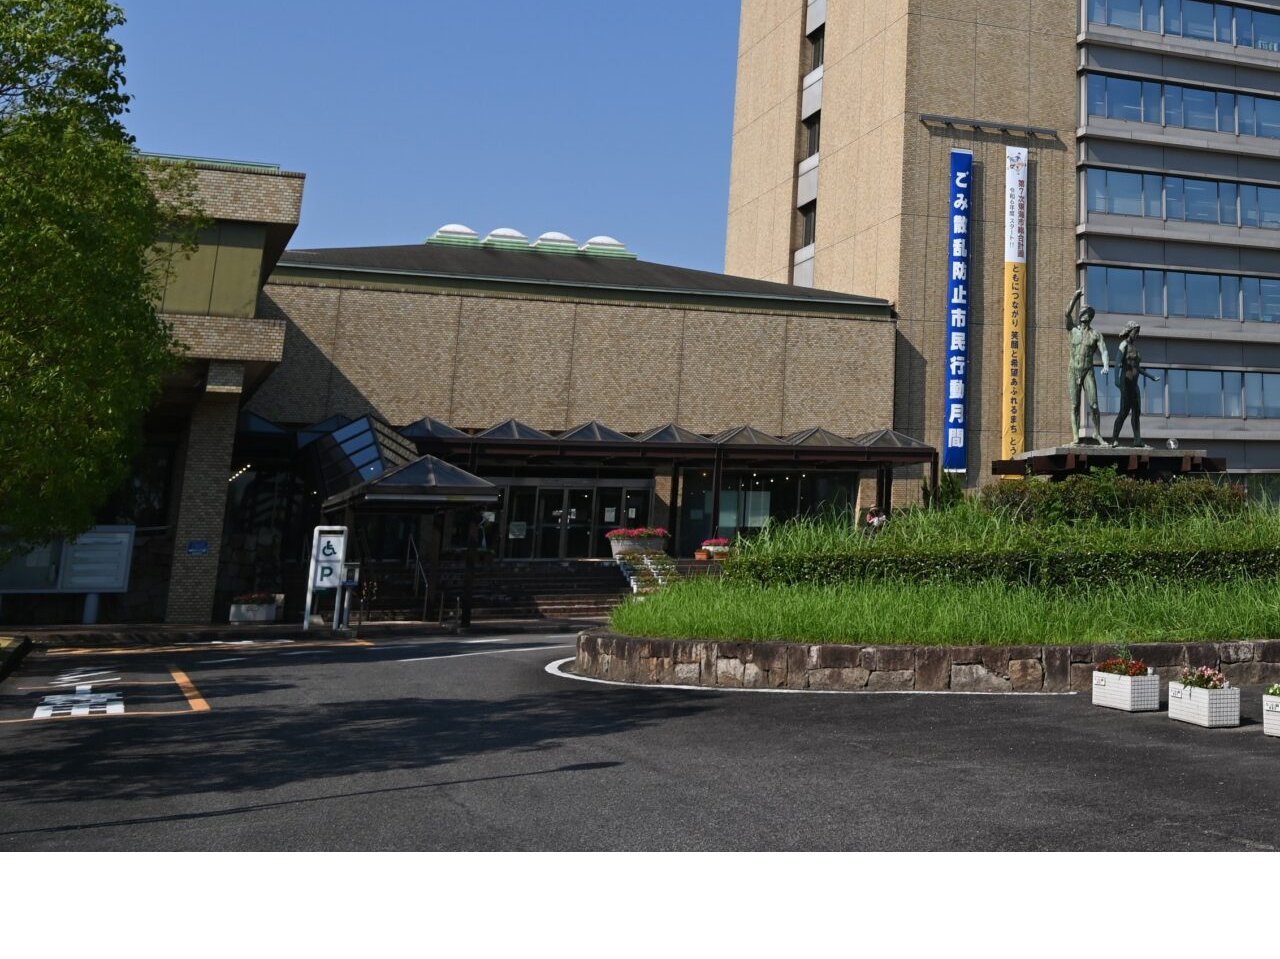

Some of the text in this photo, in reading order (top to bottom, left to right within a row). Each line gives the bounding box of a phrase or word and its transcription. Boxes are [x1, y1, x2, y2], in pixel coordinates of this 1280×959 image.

[948, 171, 969, 448] ごみ散乱防止市民行動月間
[1011, 264, 1020, 328] ともにつながり
[1010, 331, 1019, 434] 笑顔と希望あふれるまち
[319, 566, 333, 582] P
